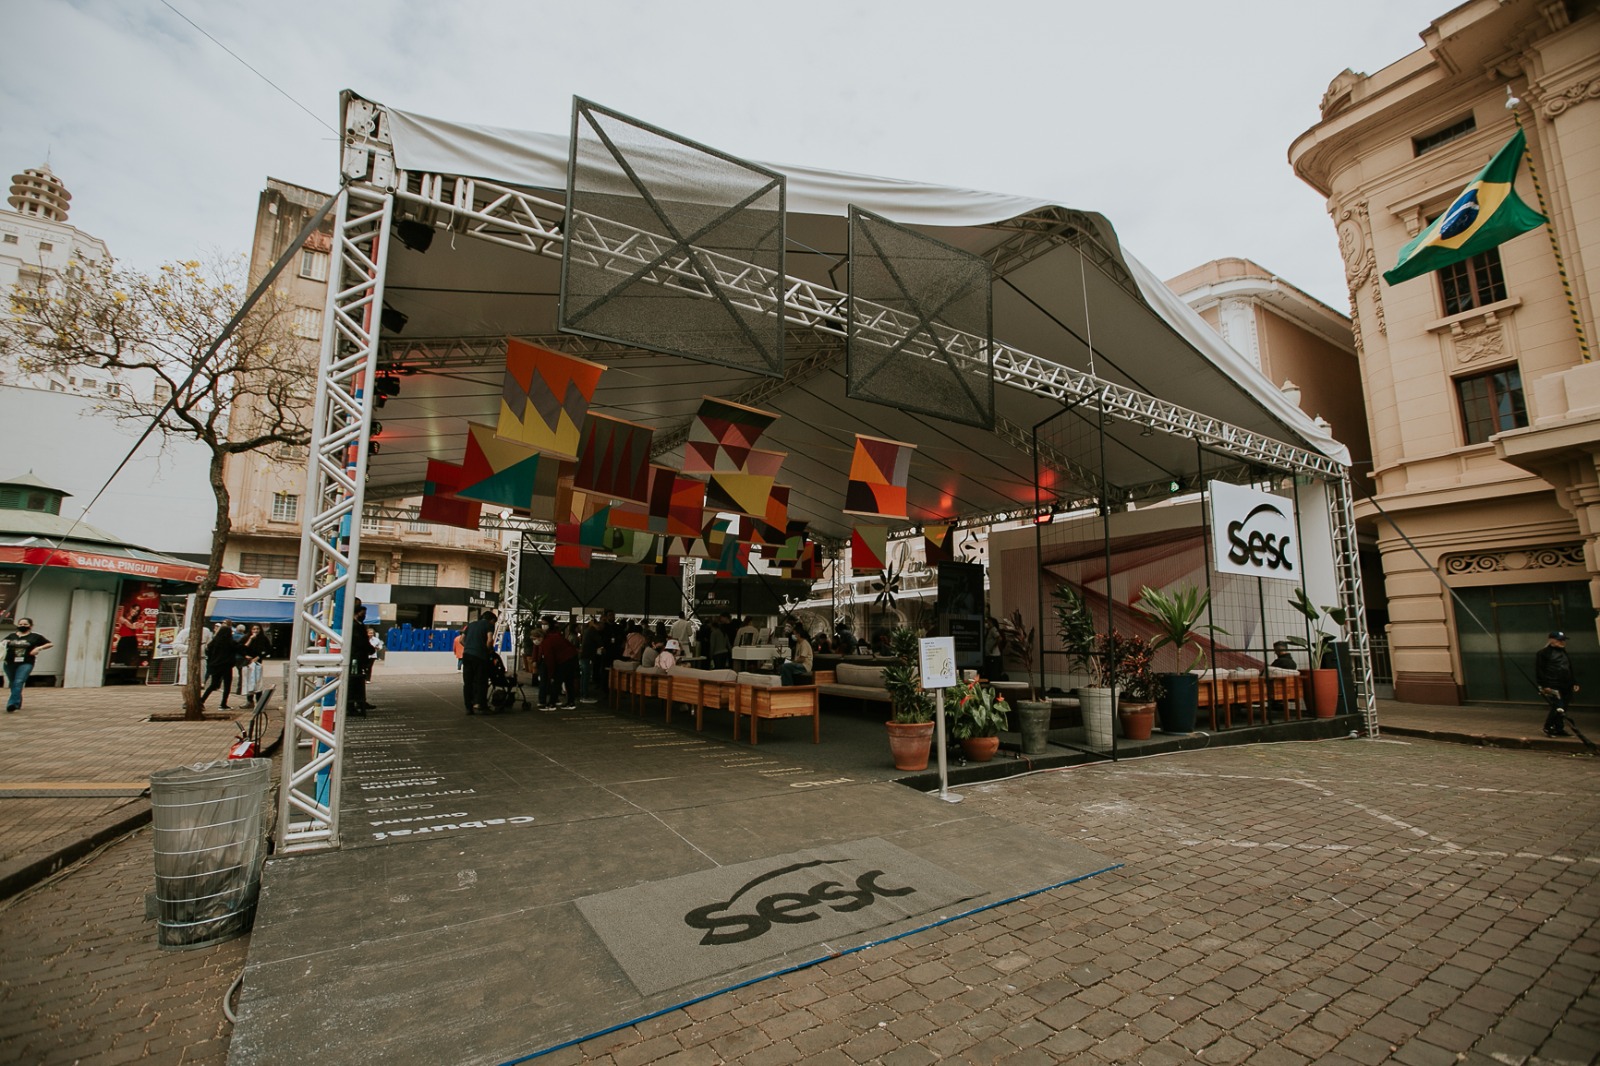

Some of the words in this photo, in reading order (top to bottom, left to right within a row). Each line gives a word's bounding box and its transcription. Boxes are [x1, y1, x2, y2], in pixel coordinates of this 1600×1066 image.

[1228, 504, 1293, 571] Sesc
[78, 556, 115, 569] BANCA
[118, 561, 159, 574] PINGUIM
[365, 788, 476, 802] Pamonha
[685, 860, 917, 945] Sesc
